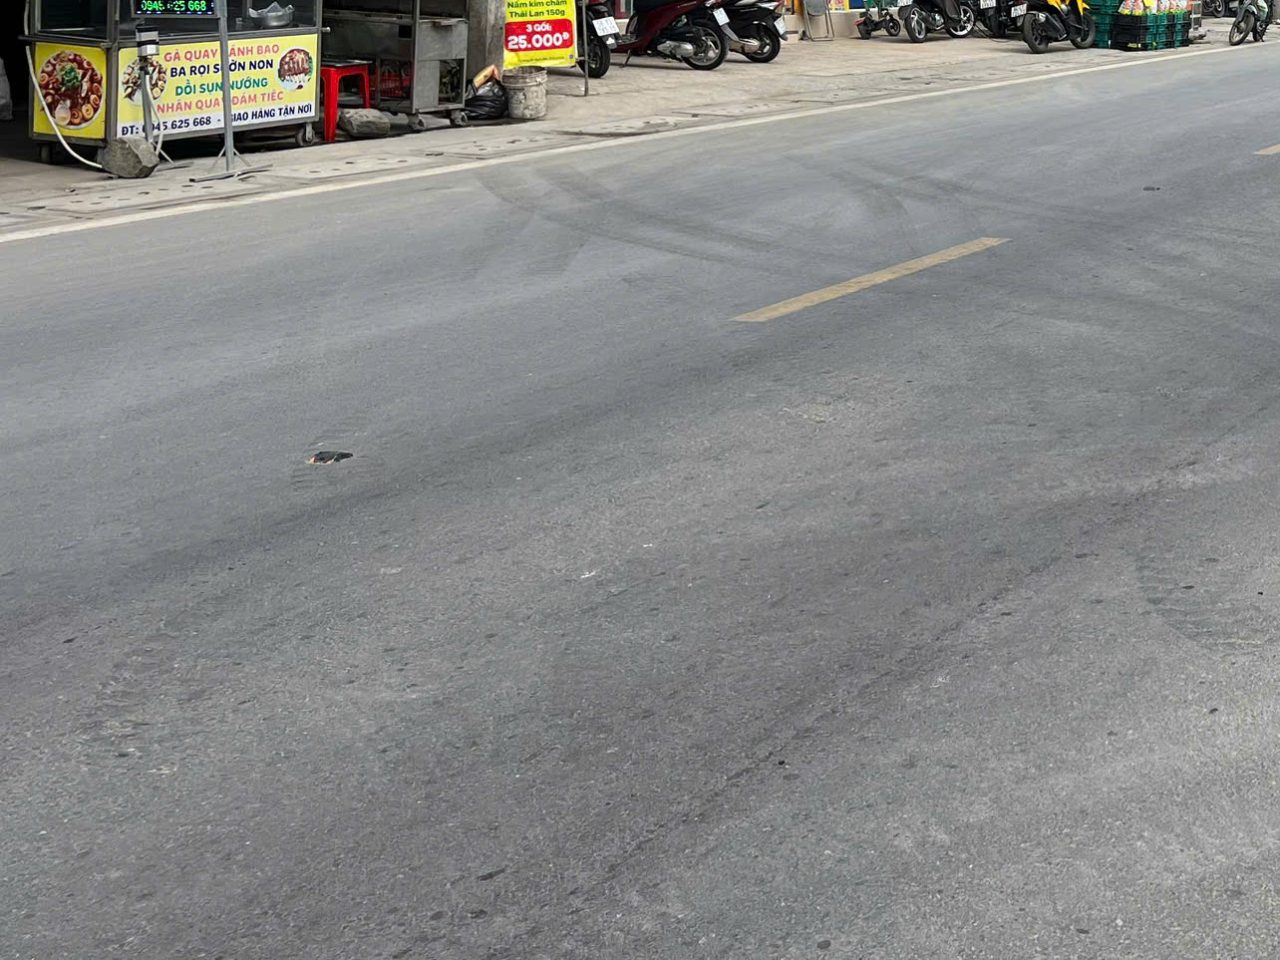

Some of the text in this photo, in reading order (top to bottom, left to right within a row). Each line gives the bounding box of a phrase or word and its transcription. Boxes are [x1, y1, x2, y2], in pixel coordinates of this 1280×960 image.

[188, 0, 207, 11] 668
[529, 0, 545, 8] kim
[529, 9, 545, 18] Lan
[546, 8, 566, 19] 150g
[164, 44, 280, 63] GÀ QUAY ÁNH BAO
[170, 59, 274, 78] BA RỌI SỜN NON
[175, 78, 197, 97] DỒI
[231, 93, 257, 107] ĐÁM
[121, 124, 139, 136] ĐT:
[171, 118, 190, 130] 625
[193, 116, 212, 127] 668
[251, 106, 276, 120] HÀNG
